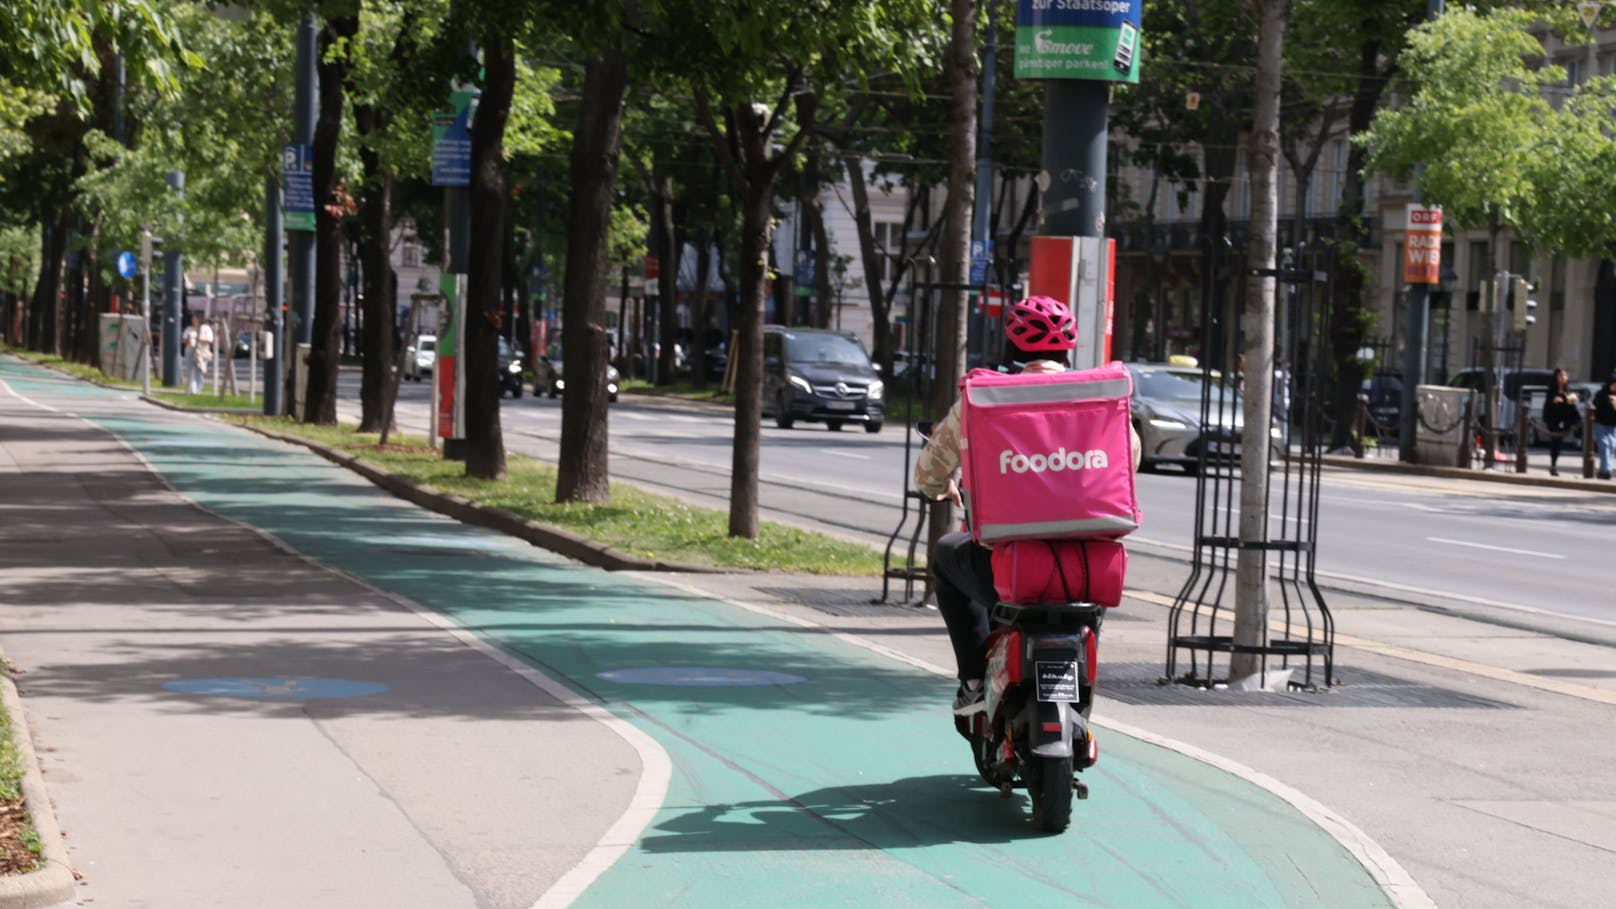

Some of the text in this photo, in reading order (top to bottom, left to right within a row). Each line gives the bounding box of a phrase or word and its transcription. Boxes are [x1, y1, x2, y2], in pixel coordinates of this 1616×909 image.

[1032, 0, 1130, 14] zur Staatsoper
[1412, 211, 1438, 223] ORF
[999, 447, 1108, 474] foodora
